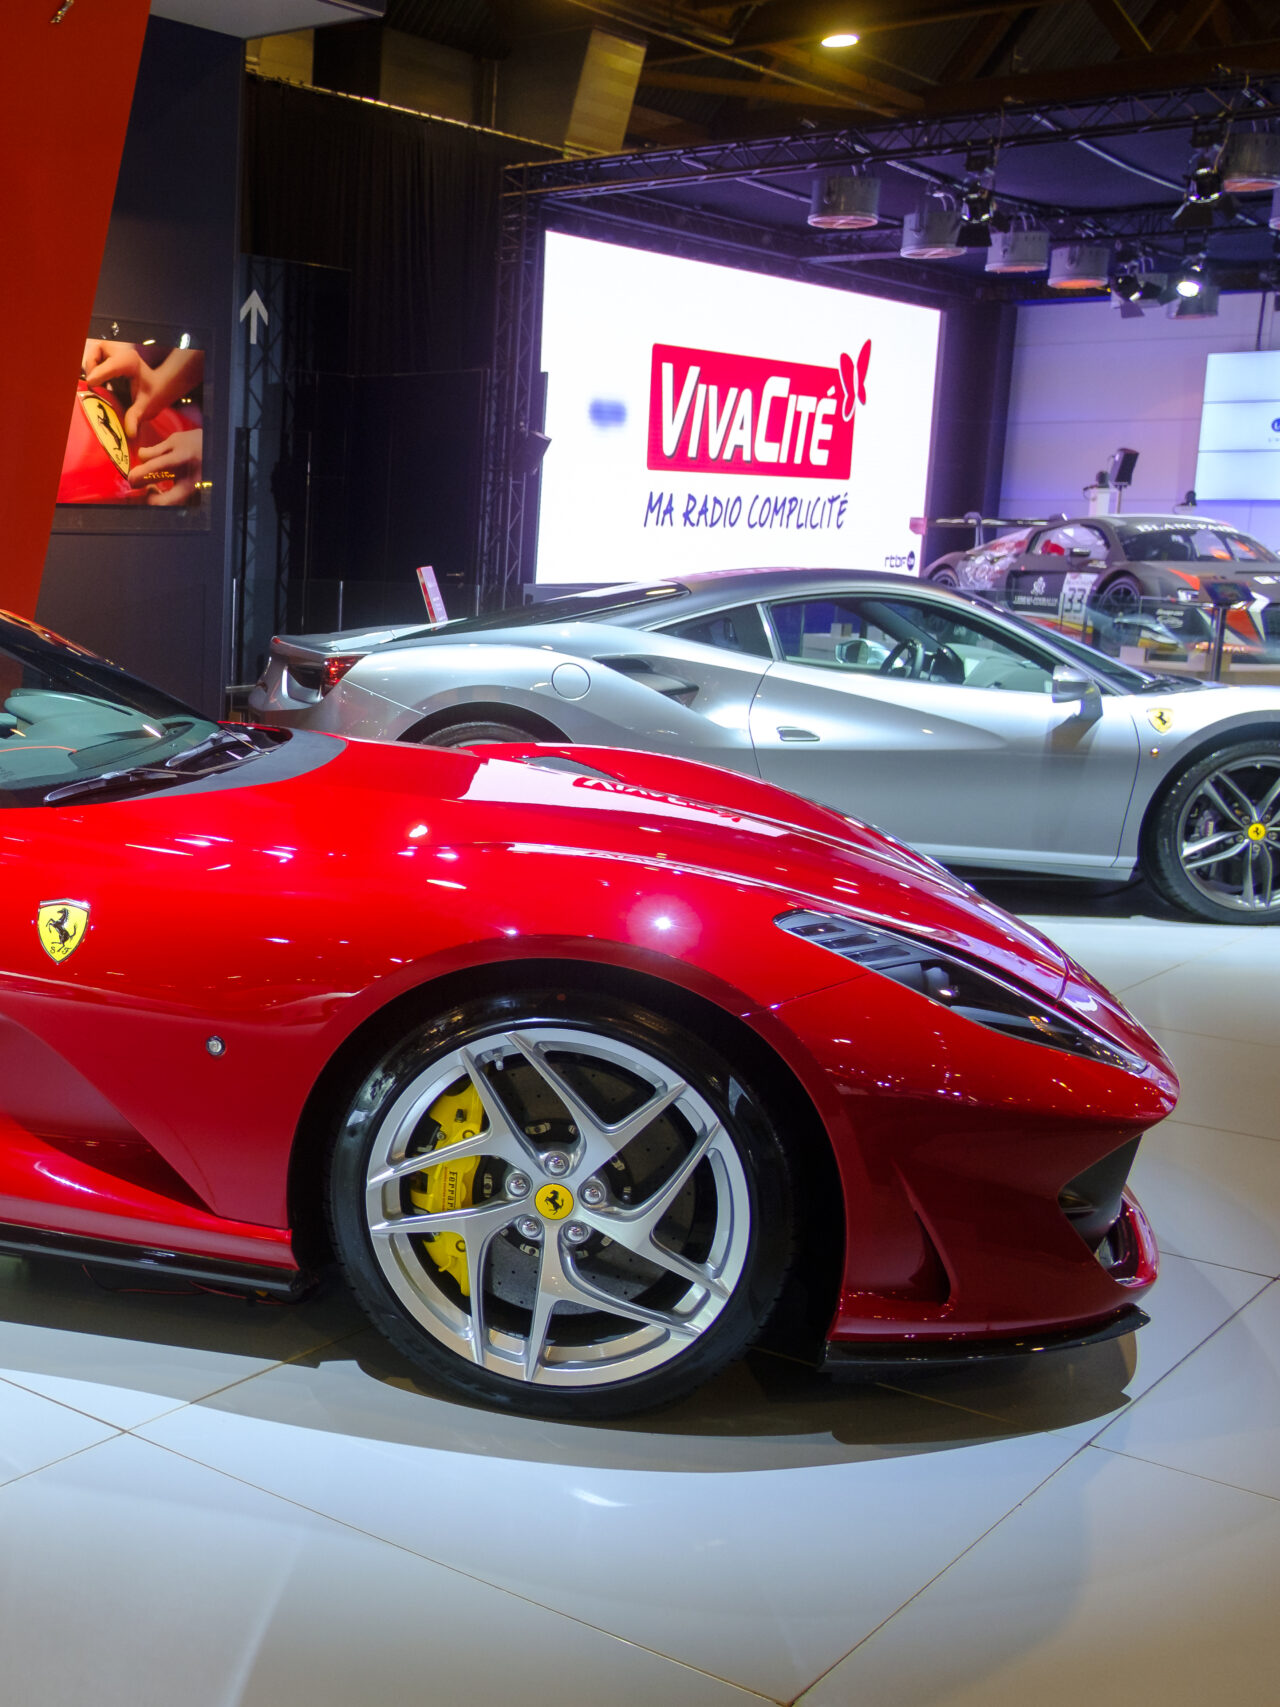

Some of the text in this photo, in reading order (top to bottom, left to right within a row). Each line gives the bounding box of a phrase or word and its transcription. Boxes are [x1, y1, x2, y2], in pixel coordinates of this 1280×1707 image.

[643, 491, 848, 529] MA RADIO COMPLICITÉ
[1063, 587, 1087, 613] 33
